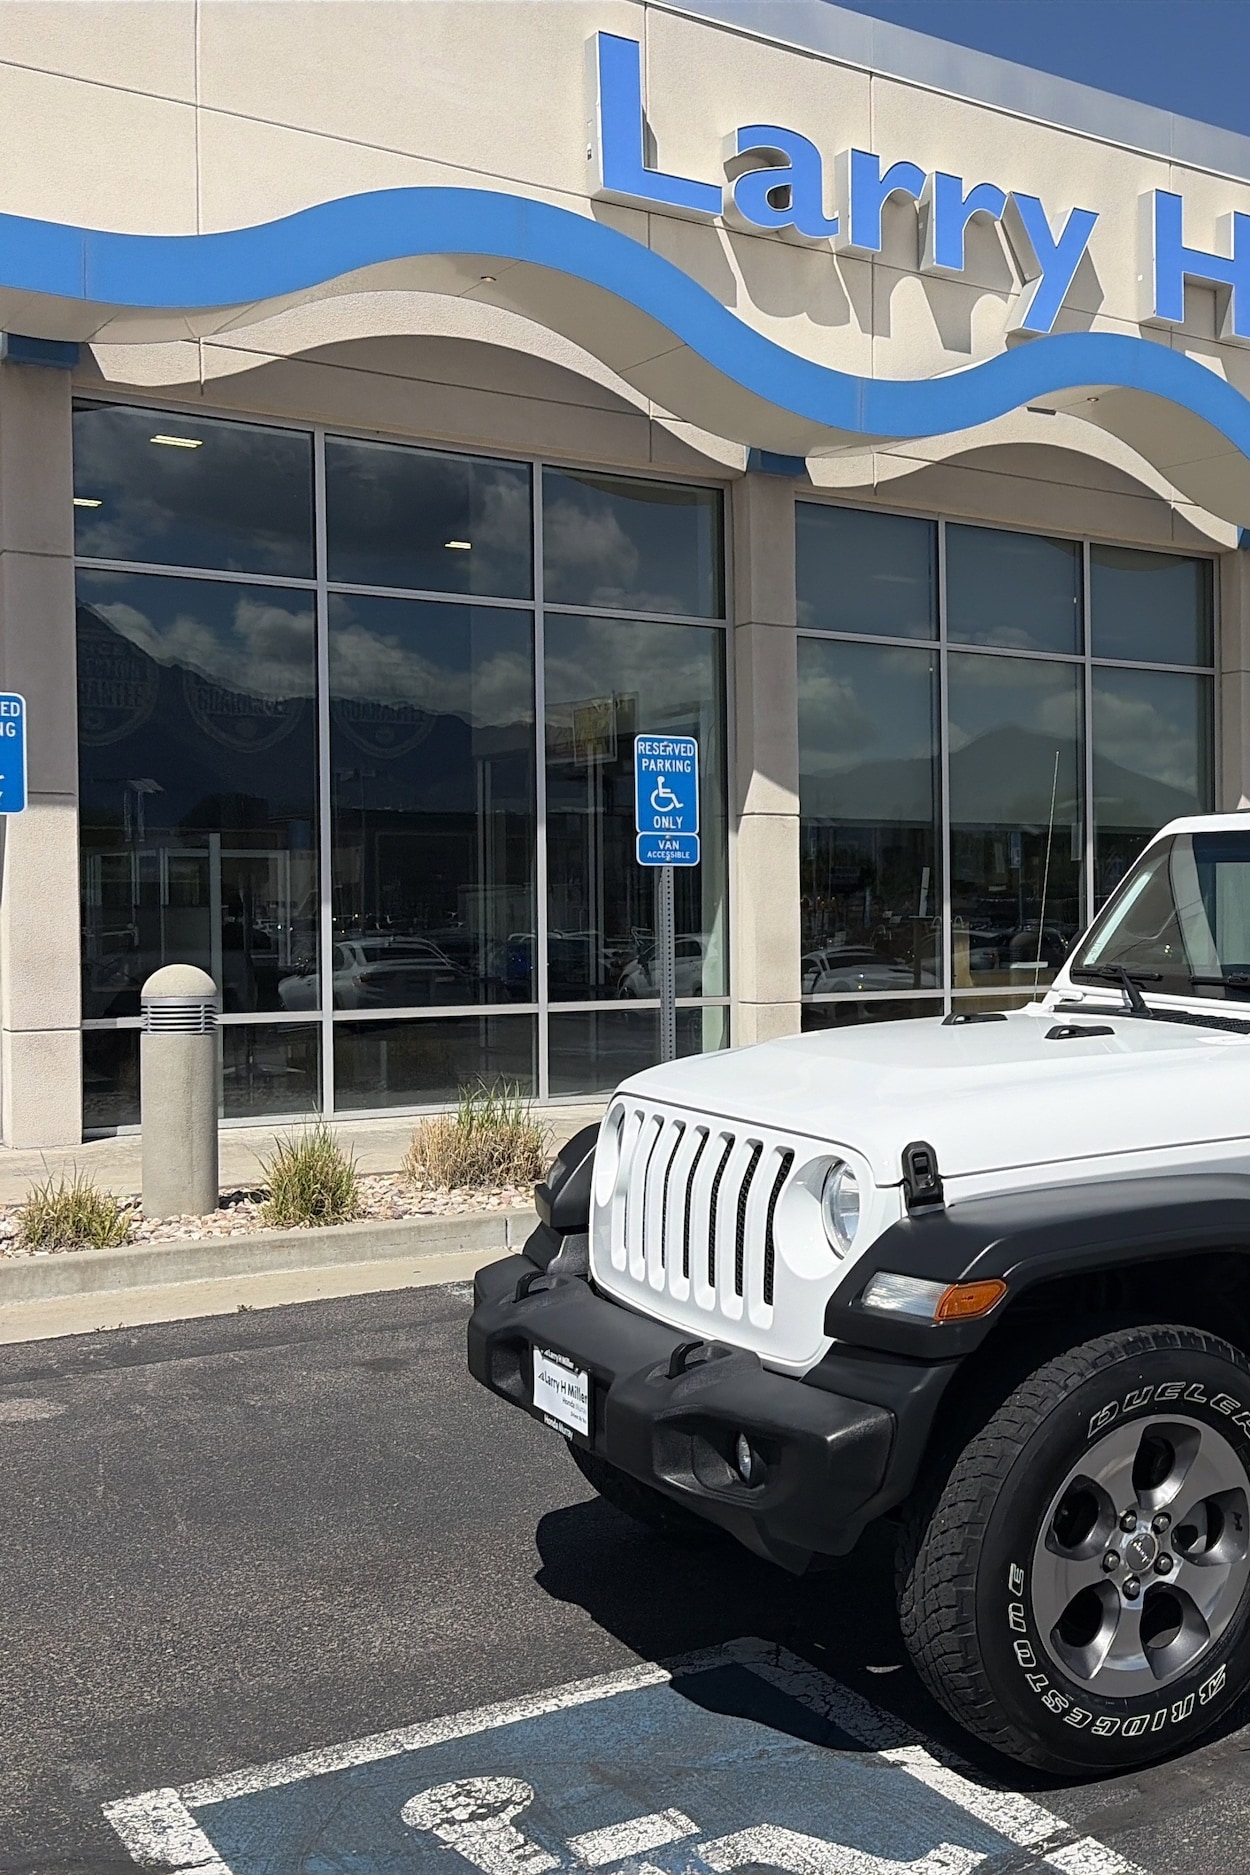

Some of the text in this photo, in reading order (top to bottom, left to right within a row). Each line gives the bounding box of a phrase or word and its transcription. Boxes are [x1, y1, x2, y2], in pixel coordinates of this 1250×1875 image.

[587, 31, 1099, 334] Larry
[638, 741, 694, 757] RESERVED
[642, 758, 691, 773] PARKING
[653, 816, 683, 829] ONLY
[658, 840, 680, 850] VAN
[647, 851, 690, 859] ACCESSIBLE
[544, 1370, 588, 1404] Larry H Miller
[1007, 1561, 1227, 1738] BRIDGESTONE
